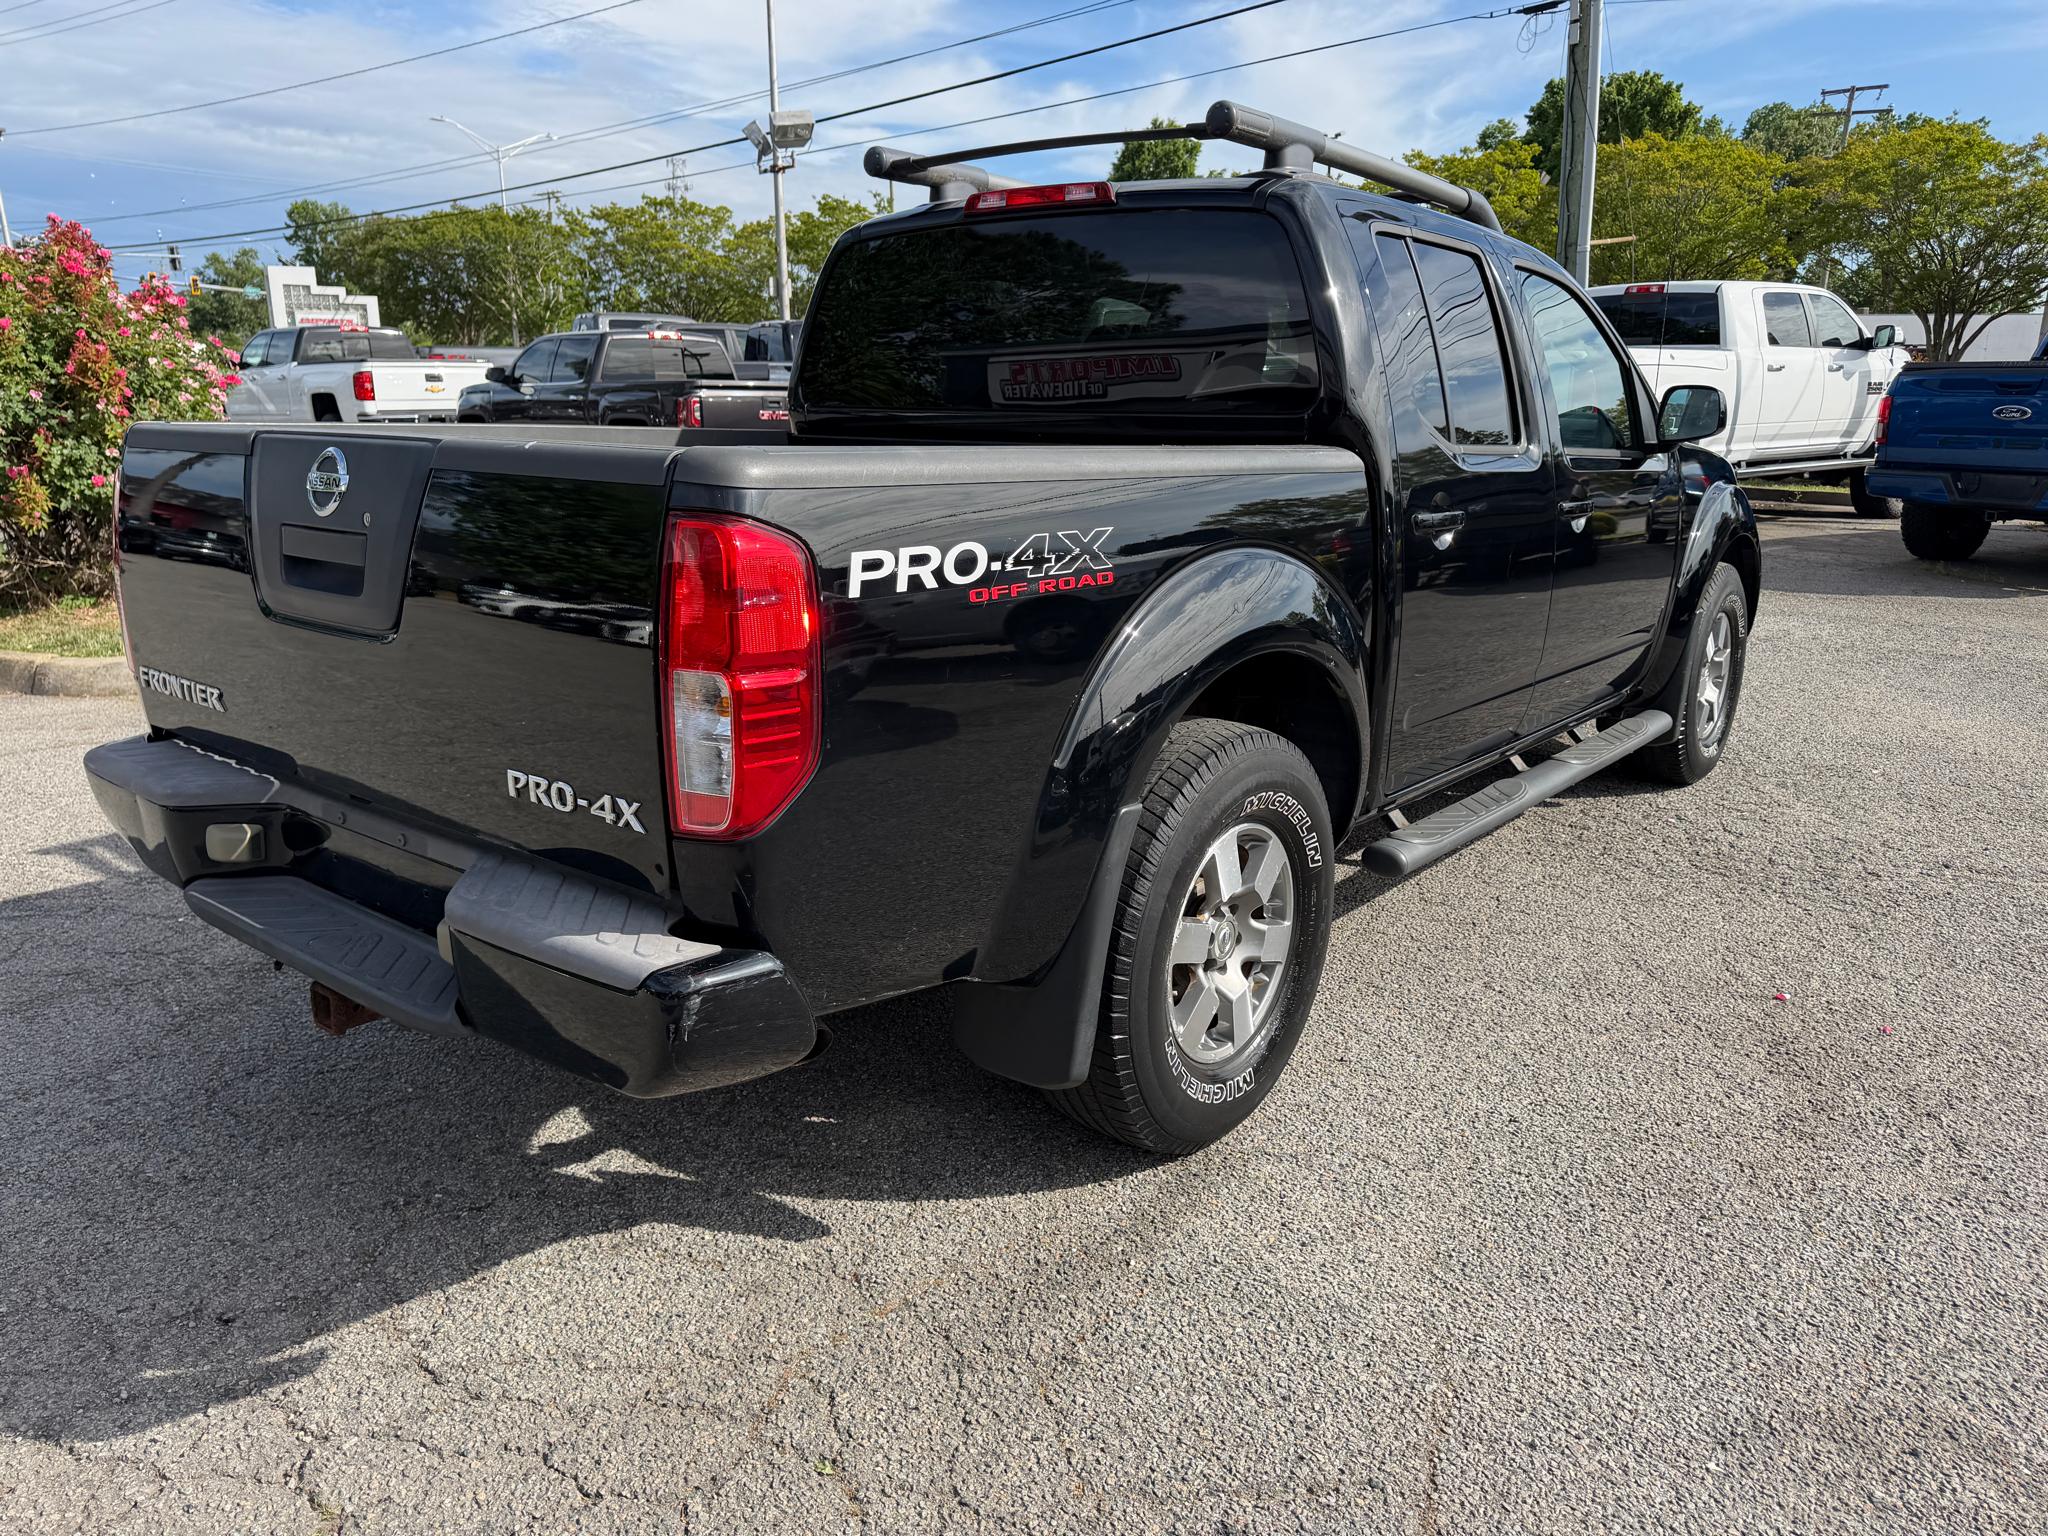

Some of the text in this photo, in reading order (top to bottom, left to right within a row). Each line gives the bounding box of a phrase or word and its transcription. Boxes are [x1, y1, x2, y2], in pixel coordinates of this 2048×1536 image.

[759, 410, 789, 420] GMC
[969, 571, 1114, 603] OFF ROAD
[139, 665, 226, 713] FRONTIER
[506, 768, 646, 835] PRO-4X
[1240, 791, 1323, 868] MICHELIN
[1164, 1037, 1255, 1104] MICHELIN
